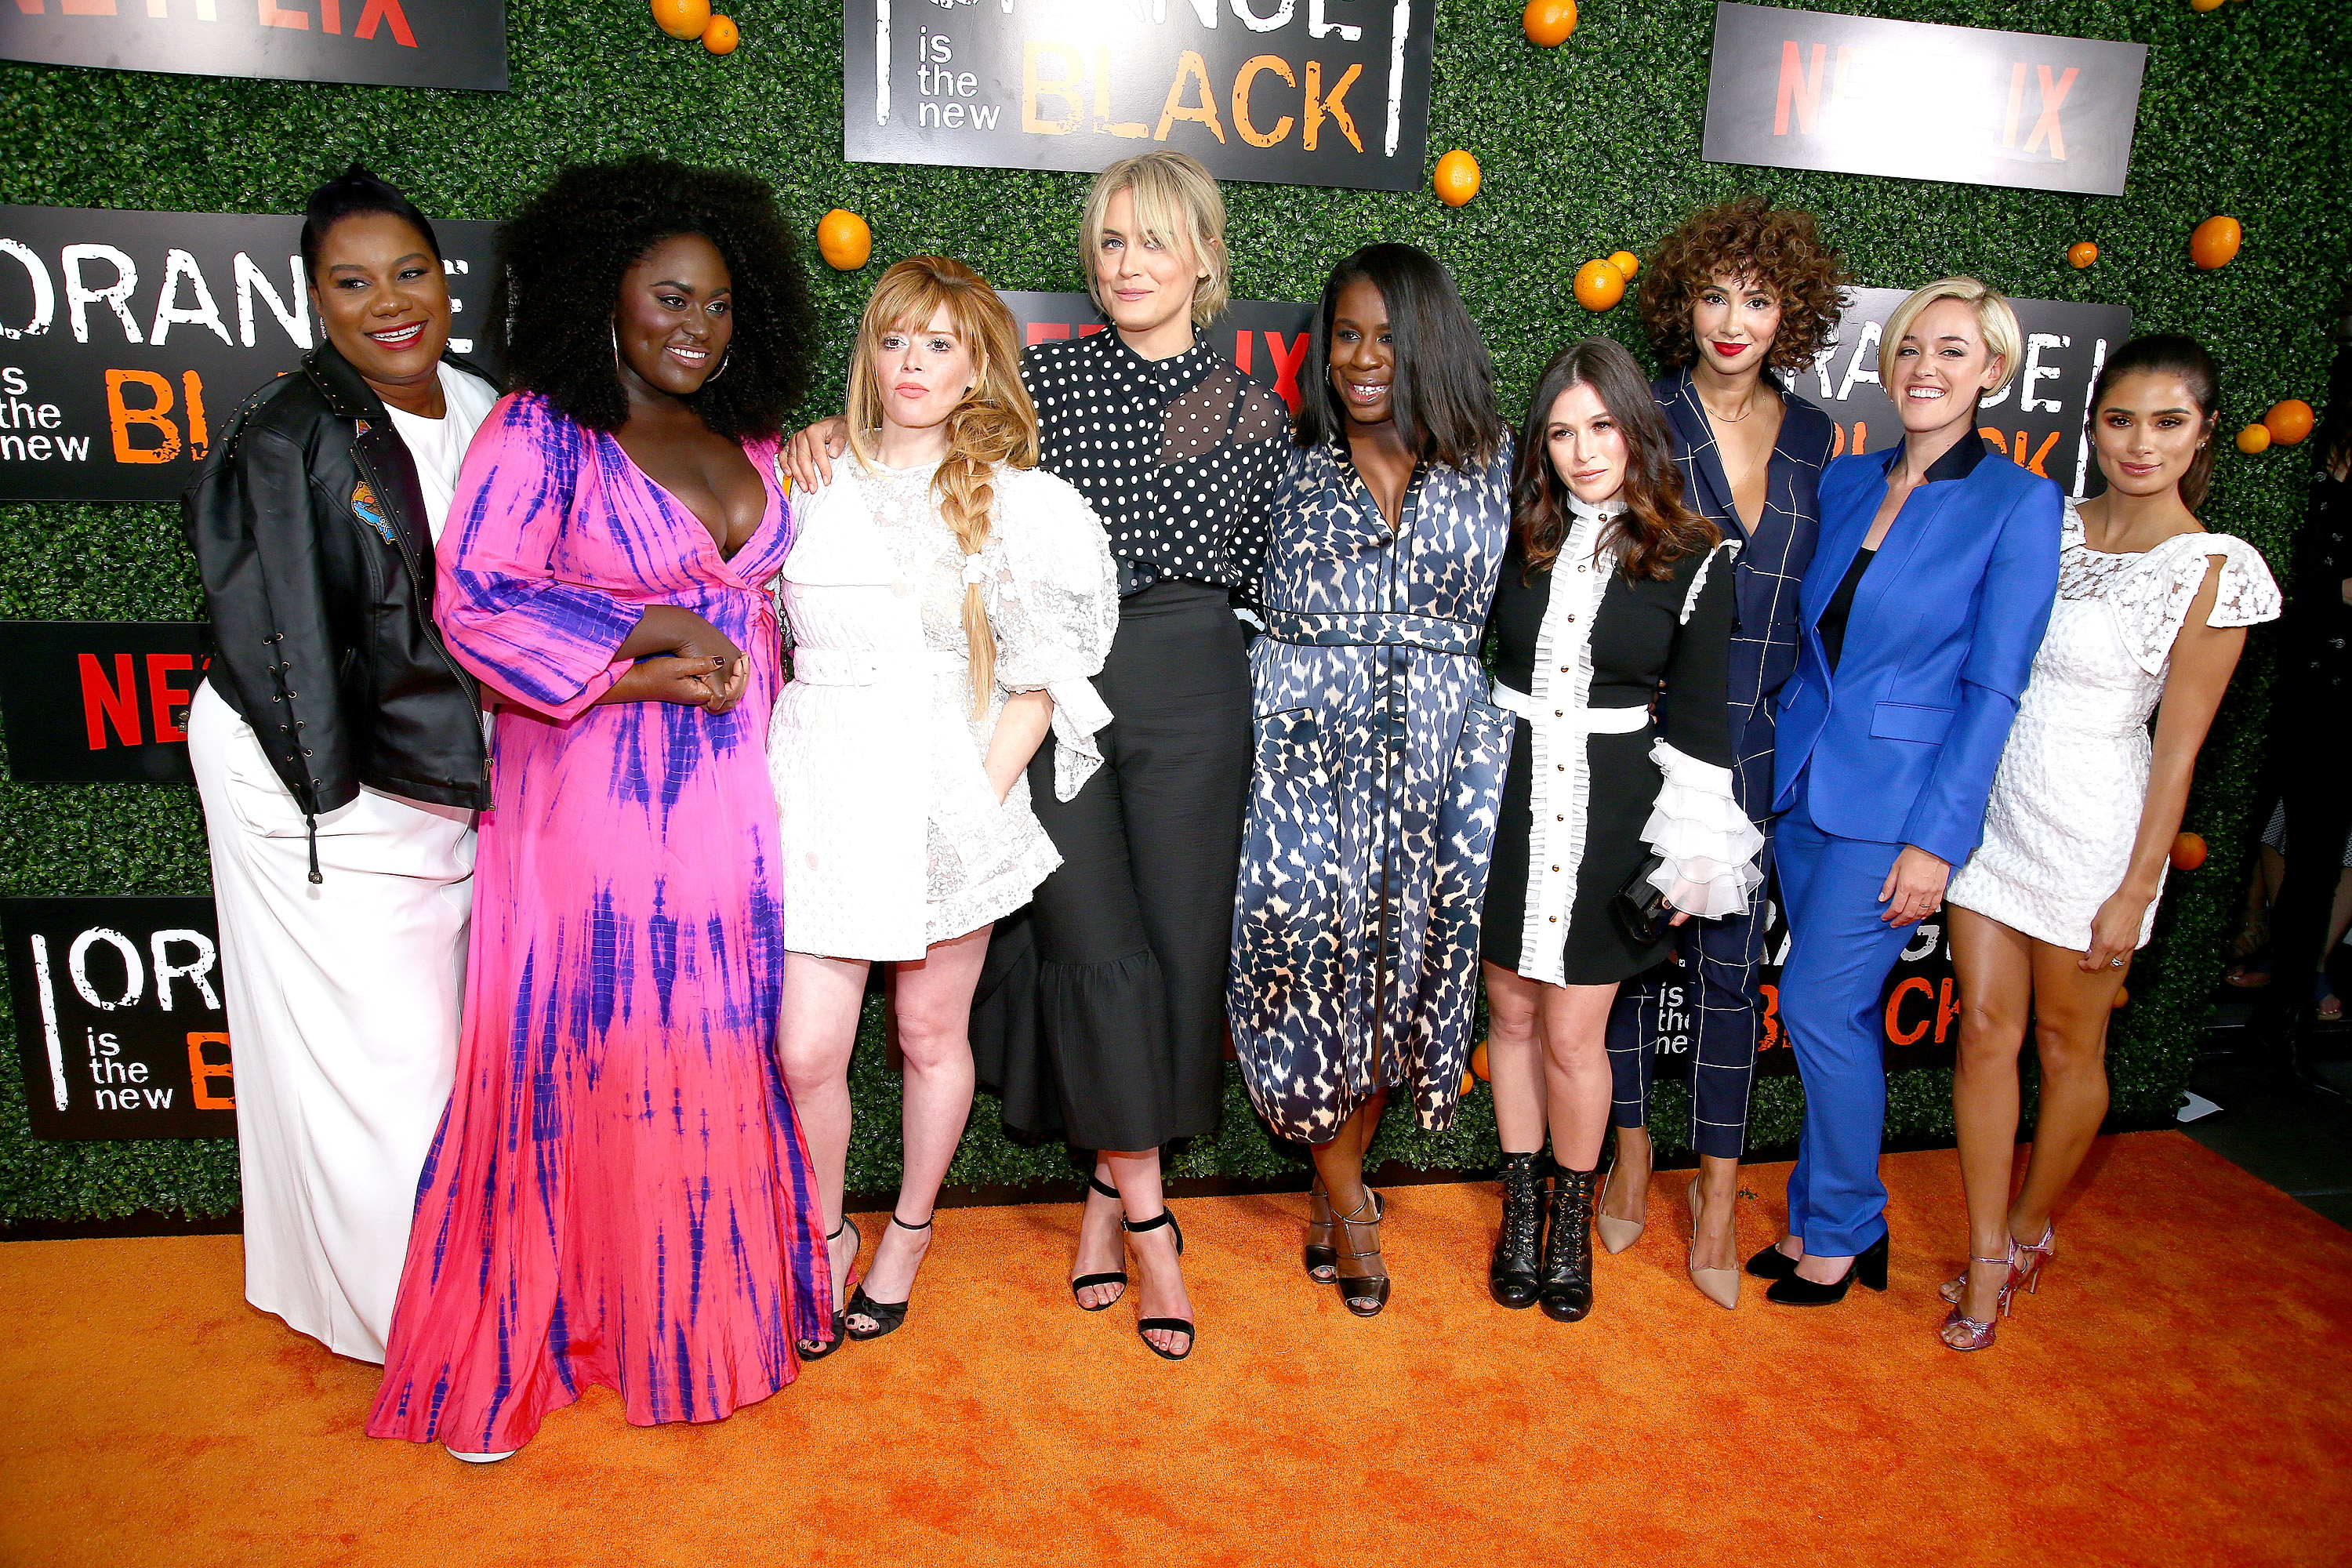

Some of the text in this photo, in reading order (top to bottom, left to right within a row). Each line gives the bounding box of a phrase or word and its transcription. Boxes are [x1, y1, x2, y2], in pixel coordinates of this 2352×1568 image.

[919, 25, 953, 64] is
[916, 64, 978, 97] the
[1022, 39, 1364, 154] BLACK
[919, 102, 1001, 131] new
[0, 396, 62, 430] the
[0, 434, 90, 462] new
[1659, 982, 1683, 1007] is
[1658, 1007, 1690, 1032] th
[87, 1026, 121, 1057] is
[1655, 1035, 1688, 1054] ne
[89, 1057, 149, 1084] the
[95, 1088, 173, 1110] new
